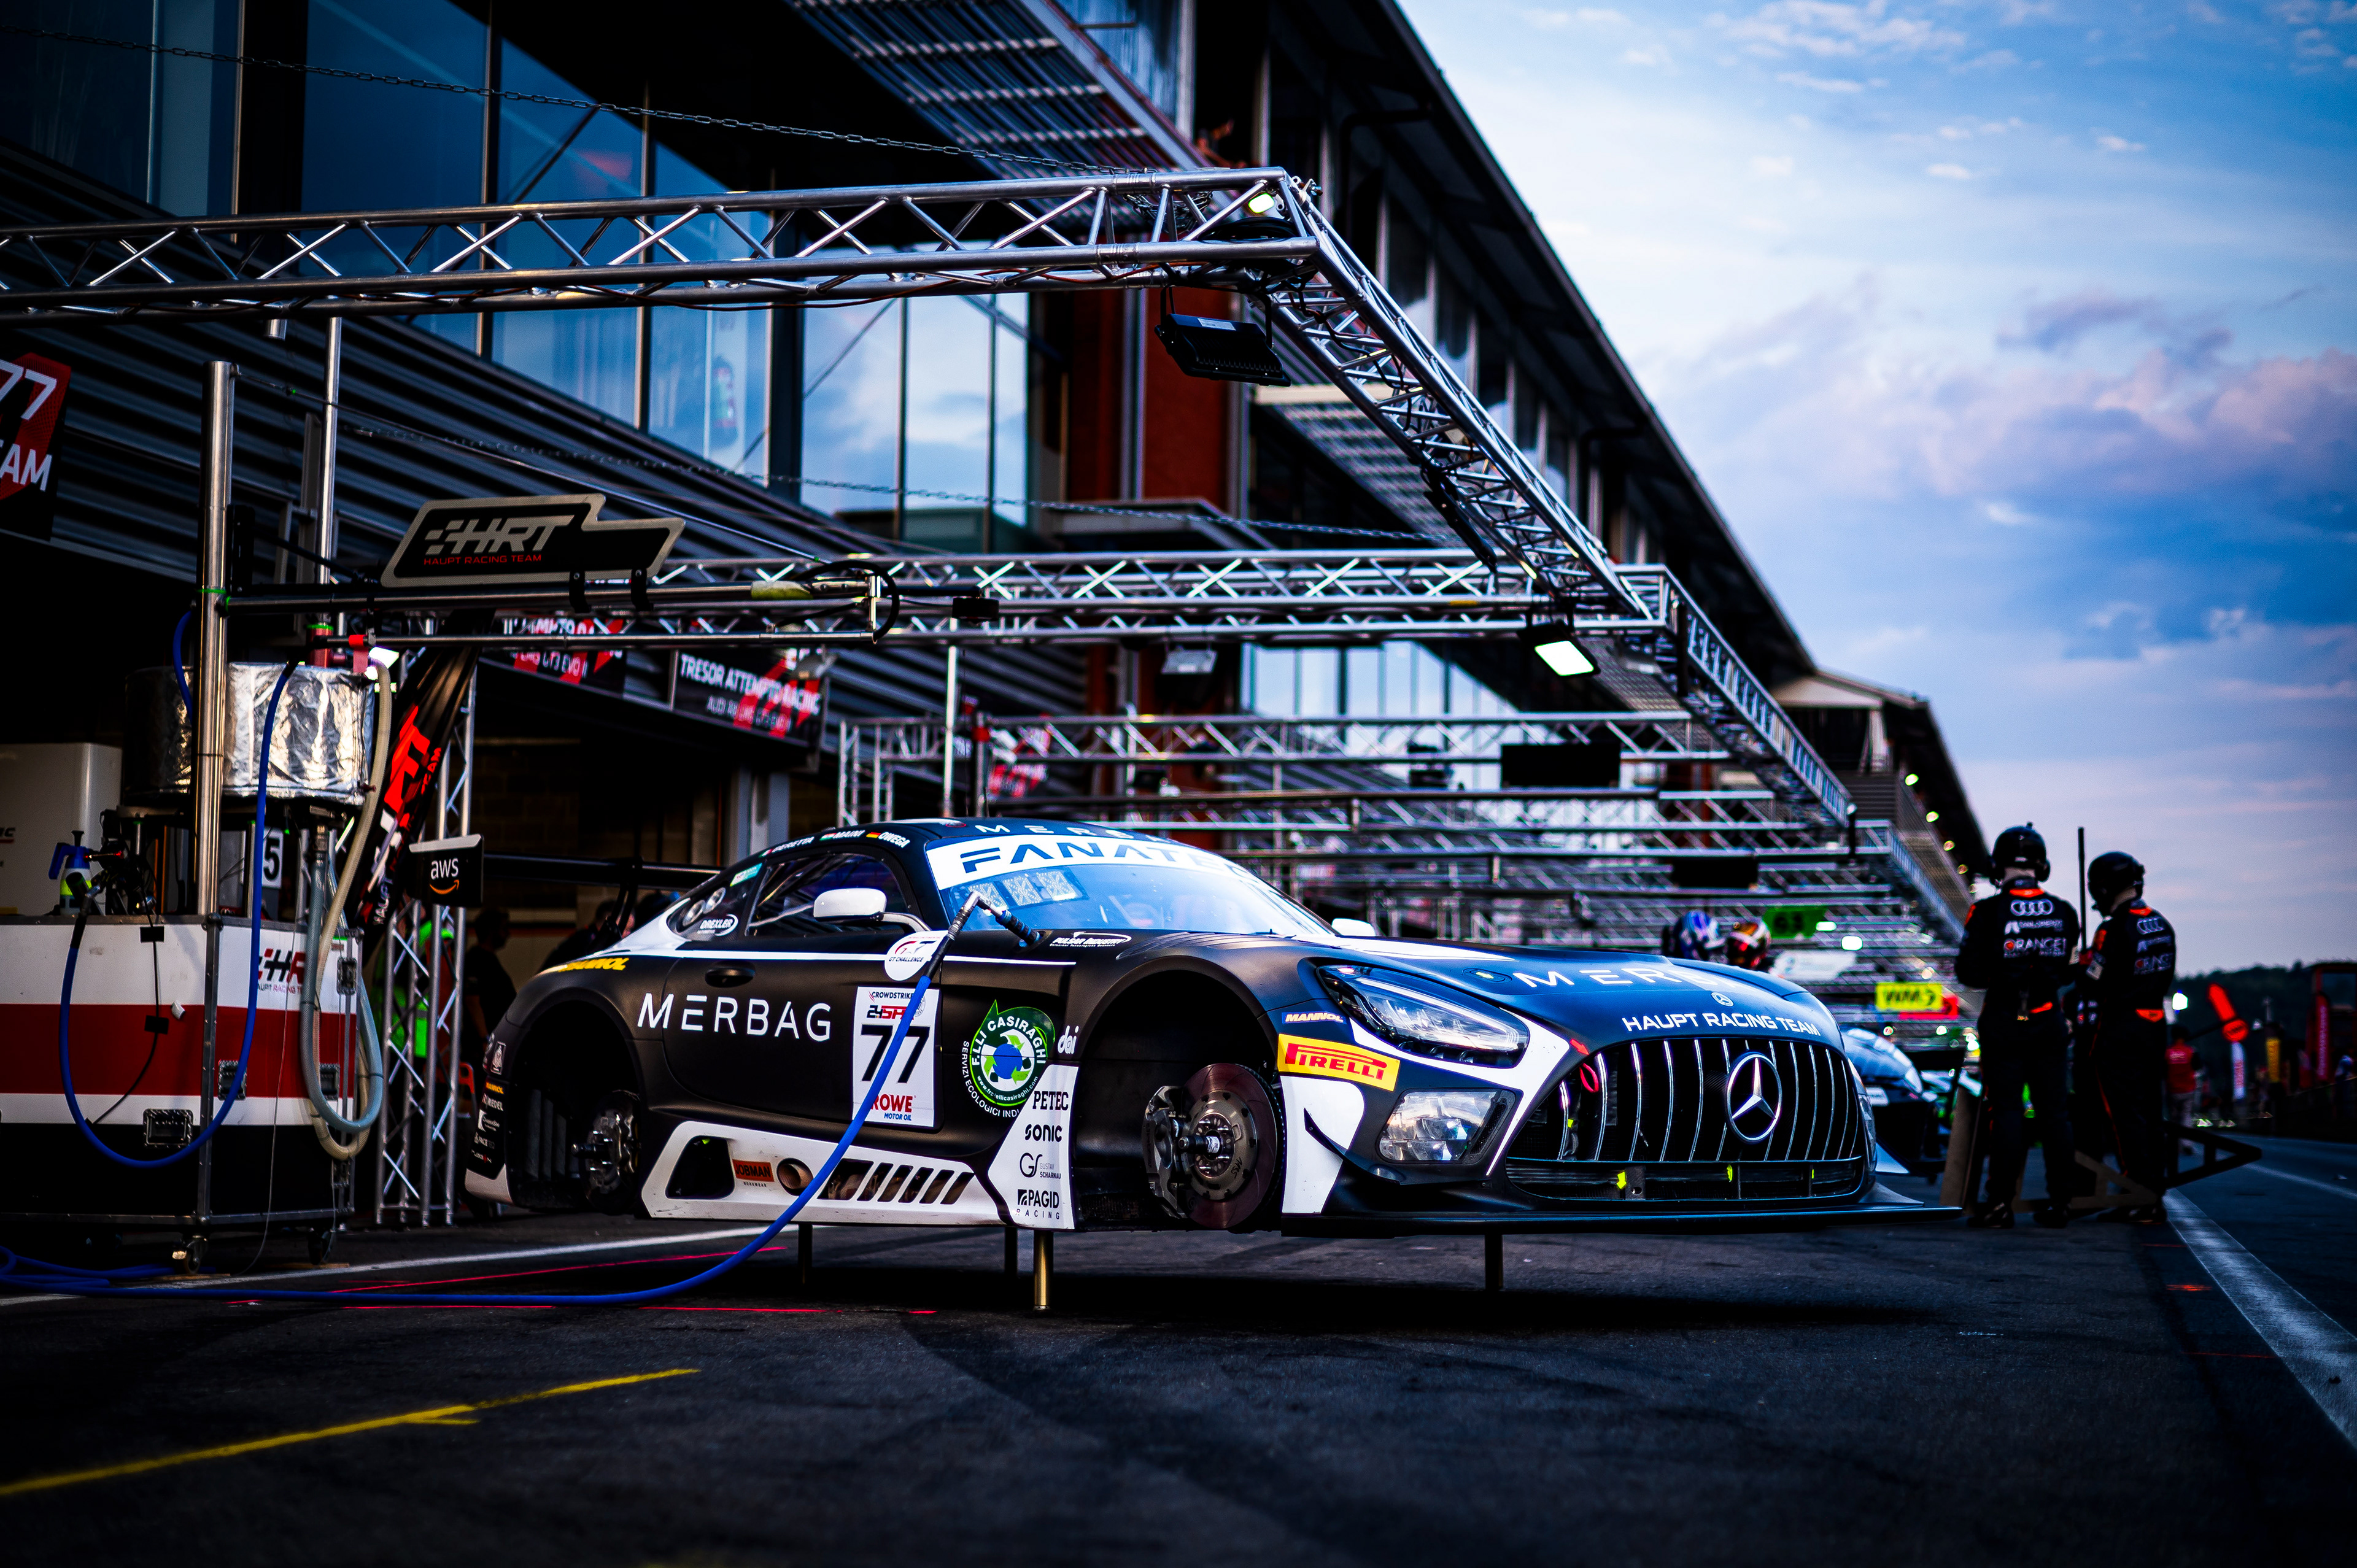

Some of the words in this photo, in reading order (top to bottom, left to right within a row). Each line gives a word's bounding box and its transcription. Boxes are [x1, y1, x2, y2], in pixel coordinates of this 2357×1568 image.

[0, 359, 57, 420] 77
[0, 439, 52, 492] AM
[445, 515, 575, 554] HRT
[424, 556, 461, 565] HAUPT
[465, 555, 508, 564] RACING
[511, 554, 541, 563] TEAM
[681, 653, 725, 687] TRESOR
[832, 830, 865, 839] MAINI
[878, 832, 910, 848] OWEGA
[431, 857, 459, 880] aws
[637, 992, 830, 1041] MERBAG
[1285, 1012, 1344, 1022] MANNOL
[1622, 1013, 1697, 1032] HAUPT
[1702, 1013, 1778, 1029] RACING
[1775, 1017, 1821, 1037] TEAM
[972, 1030, 987, 1065] F.LLI
[987, 1016, 1046, 1064] CASIRAGHI
[861, 1024, 930, 1083] 77
[1285, 1043, 1387, 1080] PIRELLI
[965, 1079, 1000, 1117] ECOLOGICI
[977, 1075, 1039, 1102] www.fraellicasiraghi.com
[1032, 1091, 1069, 1111] PETEC
[736, 1164, 771, 1178] JOBMAN
[1028, 1189, 1059, 1209] PAGID
[1016, 1208, 1060, 1219] RACING
